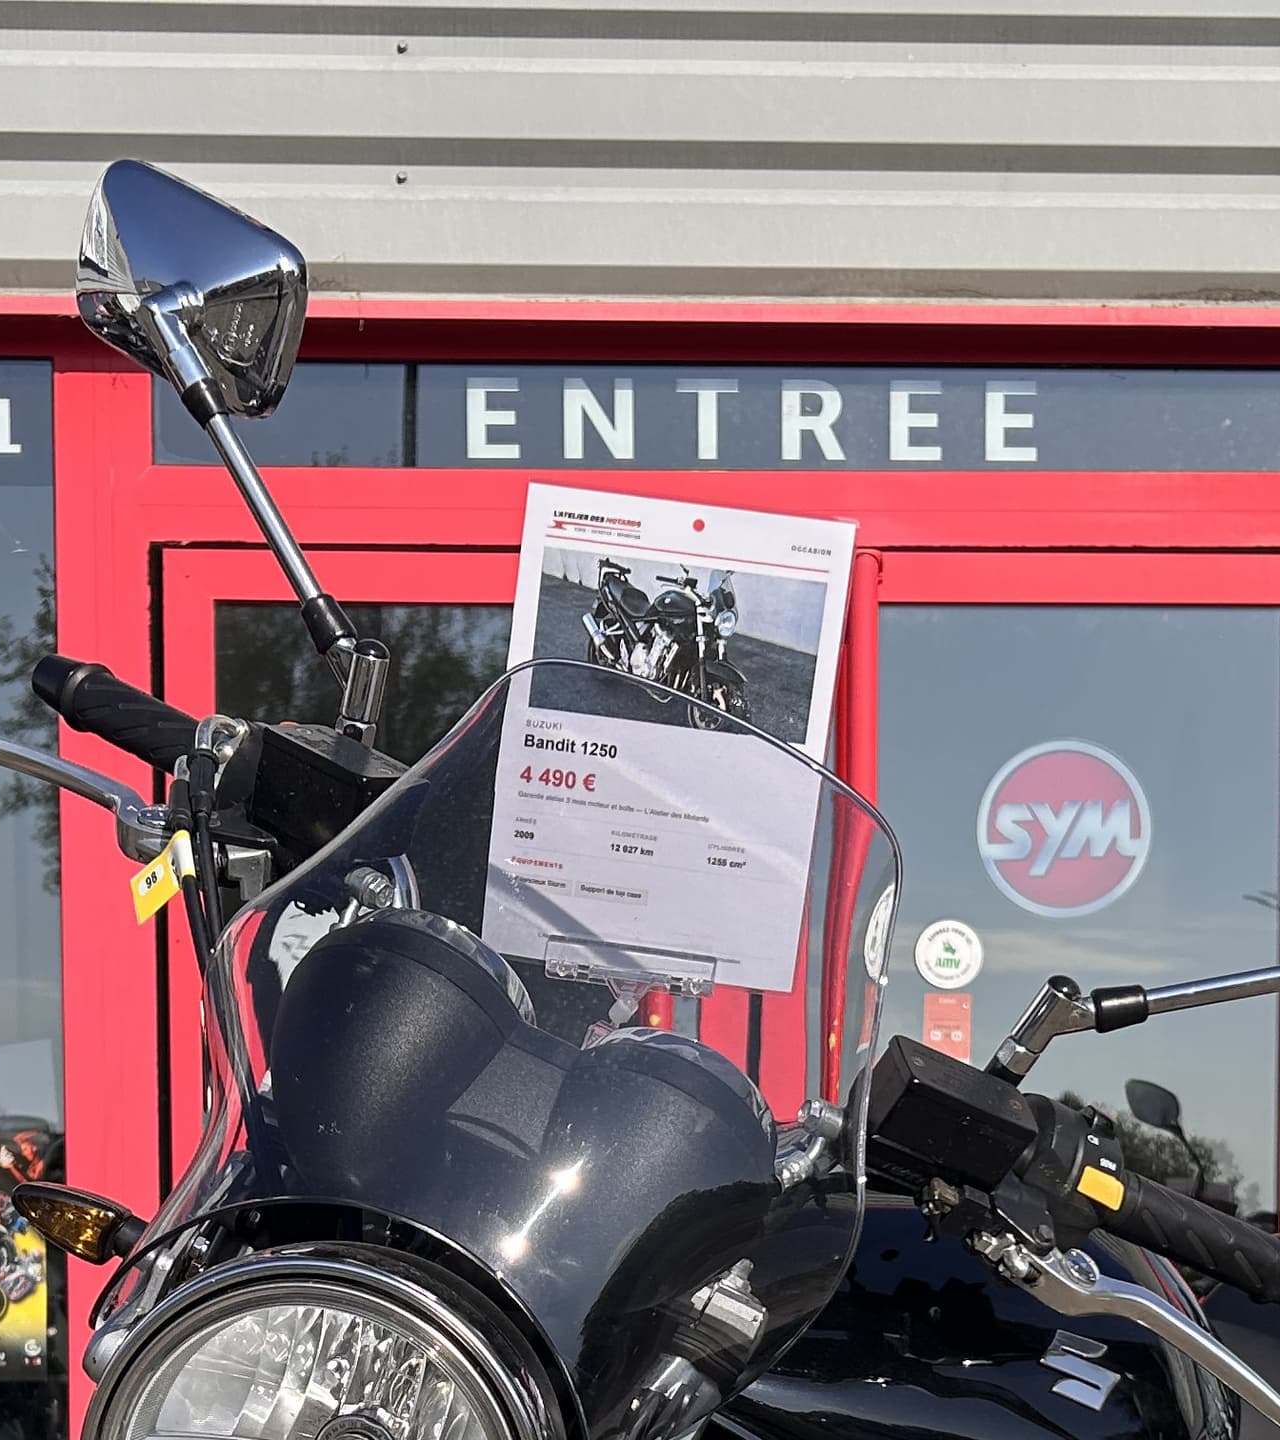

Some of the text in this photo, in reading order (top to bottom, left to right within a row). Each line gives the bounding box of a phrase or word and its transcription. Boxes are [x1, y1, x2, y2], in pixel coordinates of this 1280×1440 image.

[466, 377, 1038, 462] ENTREE
[525, 719, 562, 731] SUZUKI
[524, 734, 618, 759] Bandit 1250
[520, 766, 597, 792] 4 490 €
[610, 842, 620, 853] 12
[640, 847, 655, 857] km
[984, 799, 1138, 878] SYM
[145, 871, 158, 889] 98
